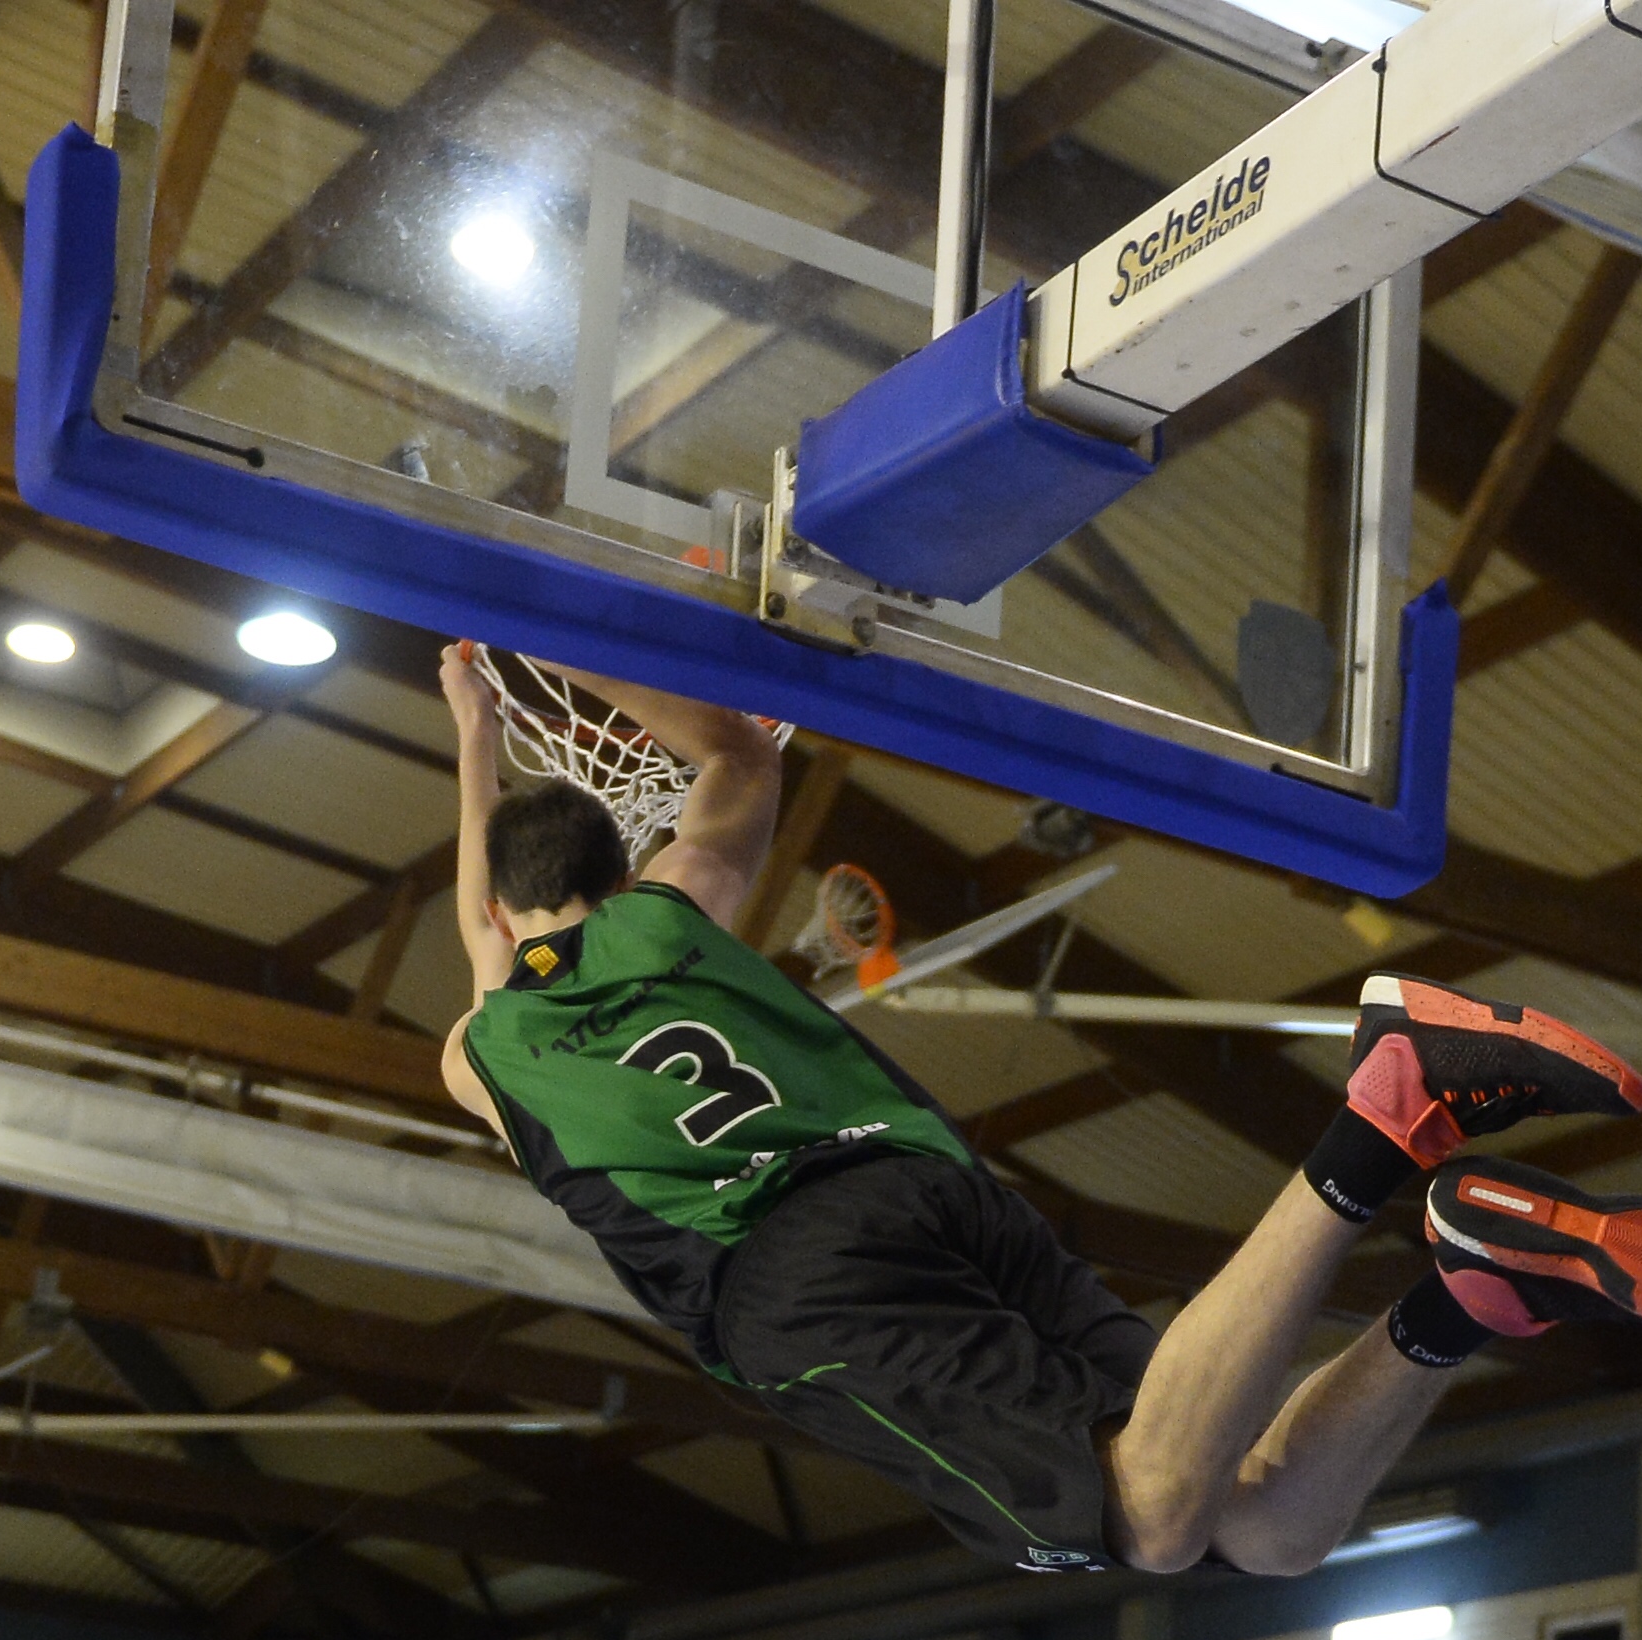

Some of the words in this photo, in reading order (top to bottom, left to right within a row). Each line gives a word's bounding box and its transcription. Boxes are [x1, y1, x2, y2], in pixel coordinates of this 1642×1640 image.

[1109, 156, 1271, 307] Schelde
[1132, 190, 1265, 296] international
[615, 1019, 783, 1148] 3
